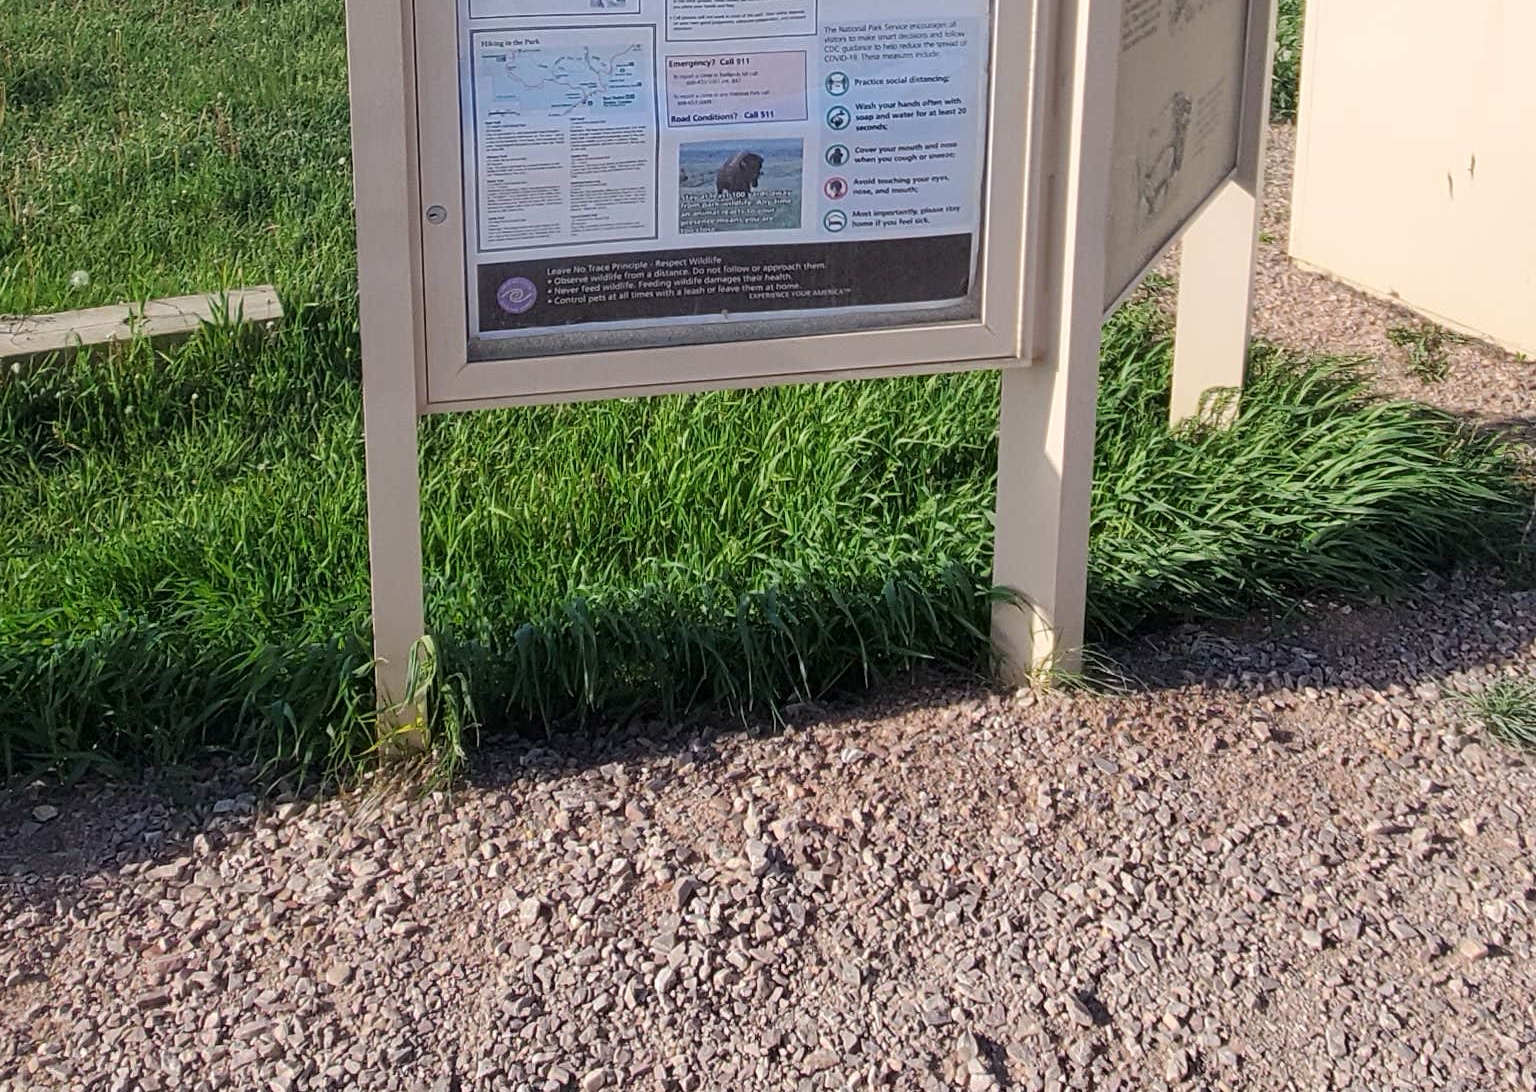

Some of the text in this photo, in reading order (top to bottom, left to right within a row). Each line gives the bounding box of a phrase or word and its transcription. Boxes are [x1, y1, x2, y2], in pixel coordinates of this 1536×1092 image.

[669, 59, 716, 69] Emergency?
[855, 75, 950, 86] Practice social distancing;
[856, 97, 962, 111] Wash your hands often with
[693, 113, 738, 121] Conditions?
[855, 145, 876, 154] Cover
[878, 146, 896, 154] your
[897, 142, 922, 151] mouth
[924, 141, 938, 150] and
[547, 265, 571, 275] Leave
[573, 264, 585, 273] No
[588, 263, 610, 272] Trace
[611, 261, 647, 273] Principle
[655, 258, 686, 270] Respect
[688, 256, 722, 266] Wildlife
[554, 275, 588, 284] Observe
[590, 273, 621, 282] wildlife
[624, 272, 644, 281] from
[653, 269, 689, 279] distance.
[706, 267, 720, 276] not
[723, 266, 749, 275] follow
[762, 263, 801, 275] approach
